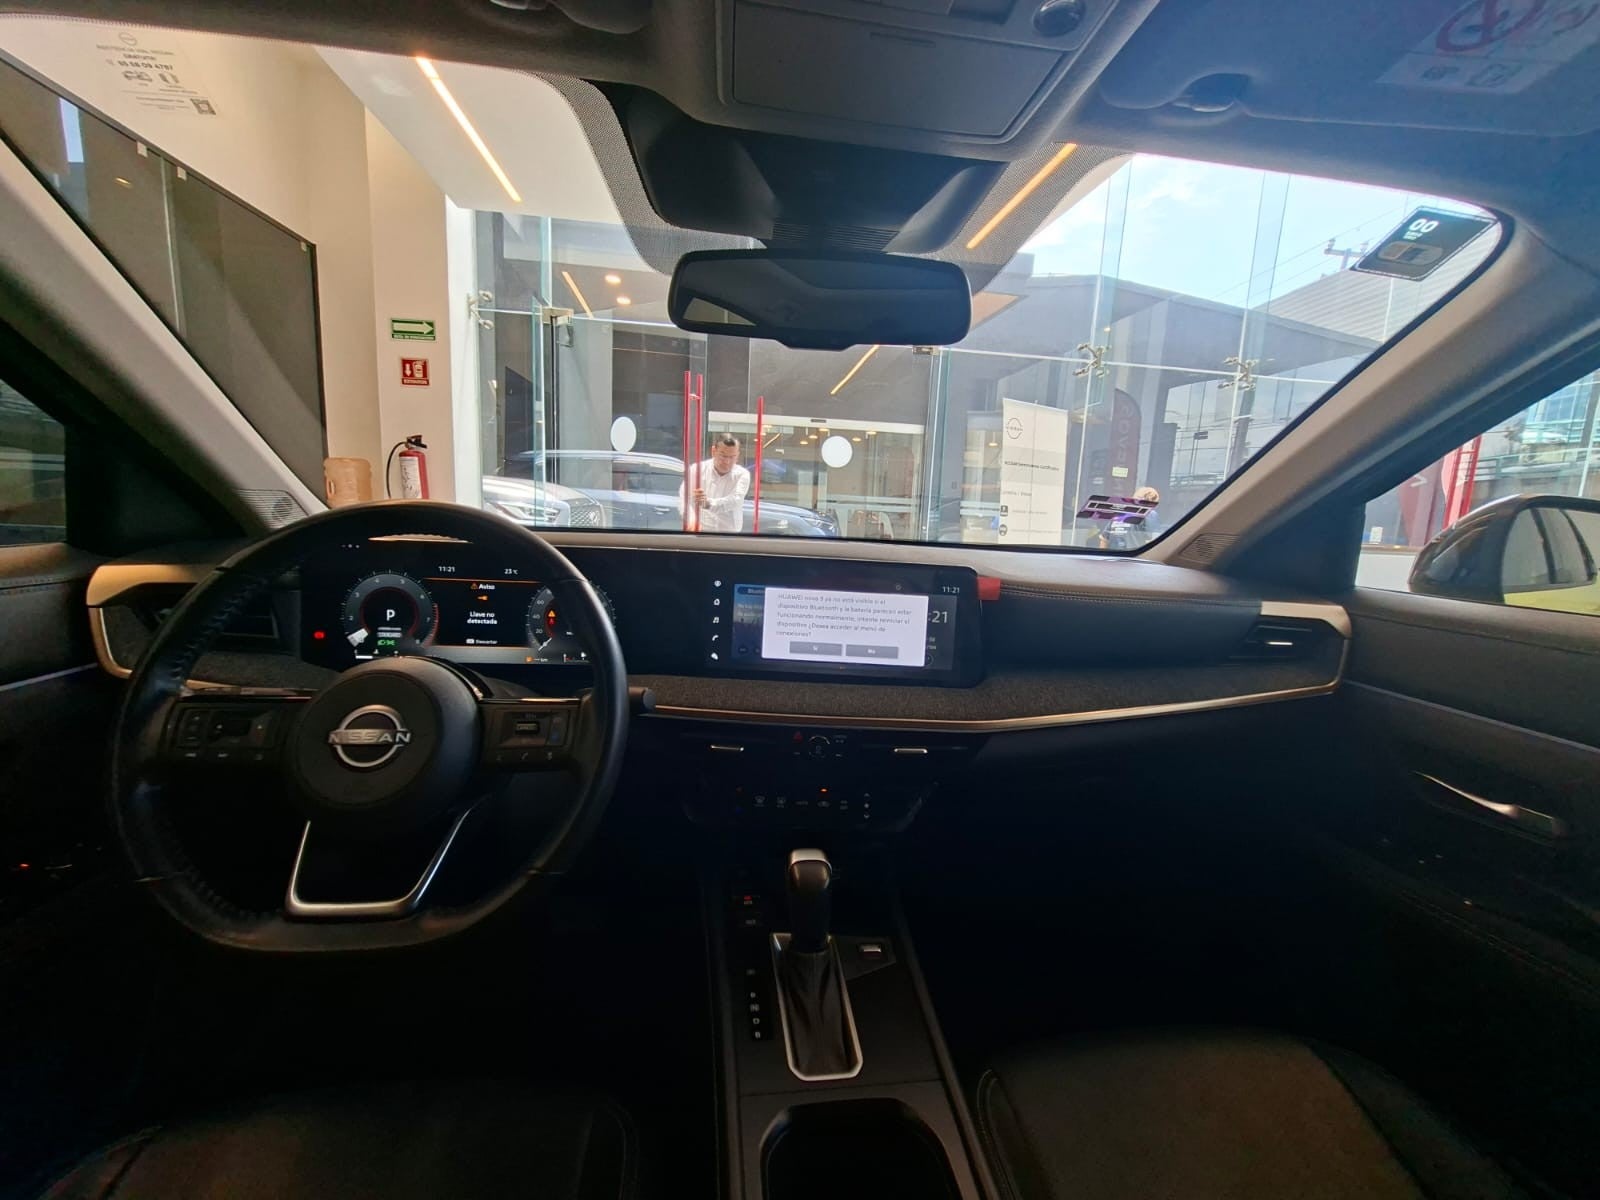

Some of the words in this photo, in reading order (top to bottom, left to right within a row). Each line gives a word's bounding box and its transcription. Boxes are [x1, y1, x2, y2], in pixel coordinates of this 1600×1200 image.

[778, 593, 803, 601] HUAWEI
[810, 604, 838, 612] Bluetooth
[386, 609, 395, 621] P
[928, 610, 948, 623] :21
[328, 732, 411, 743] NISSAN
